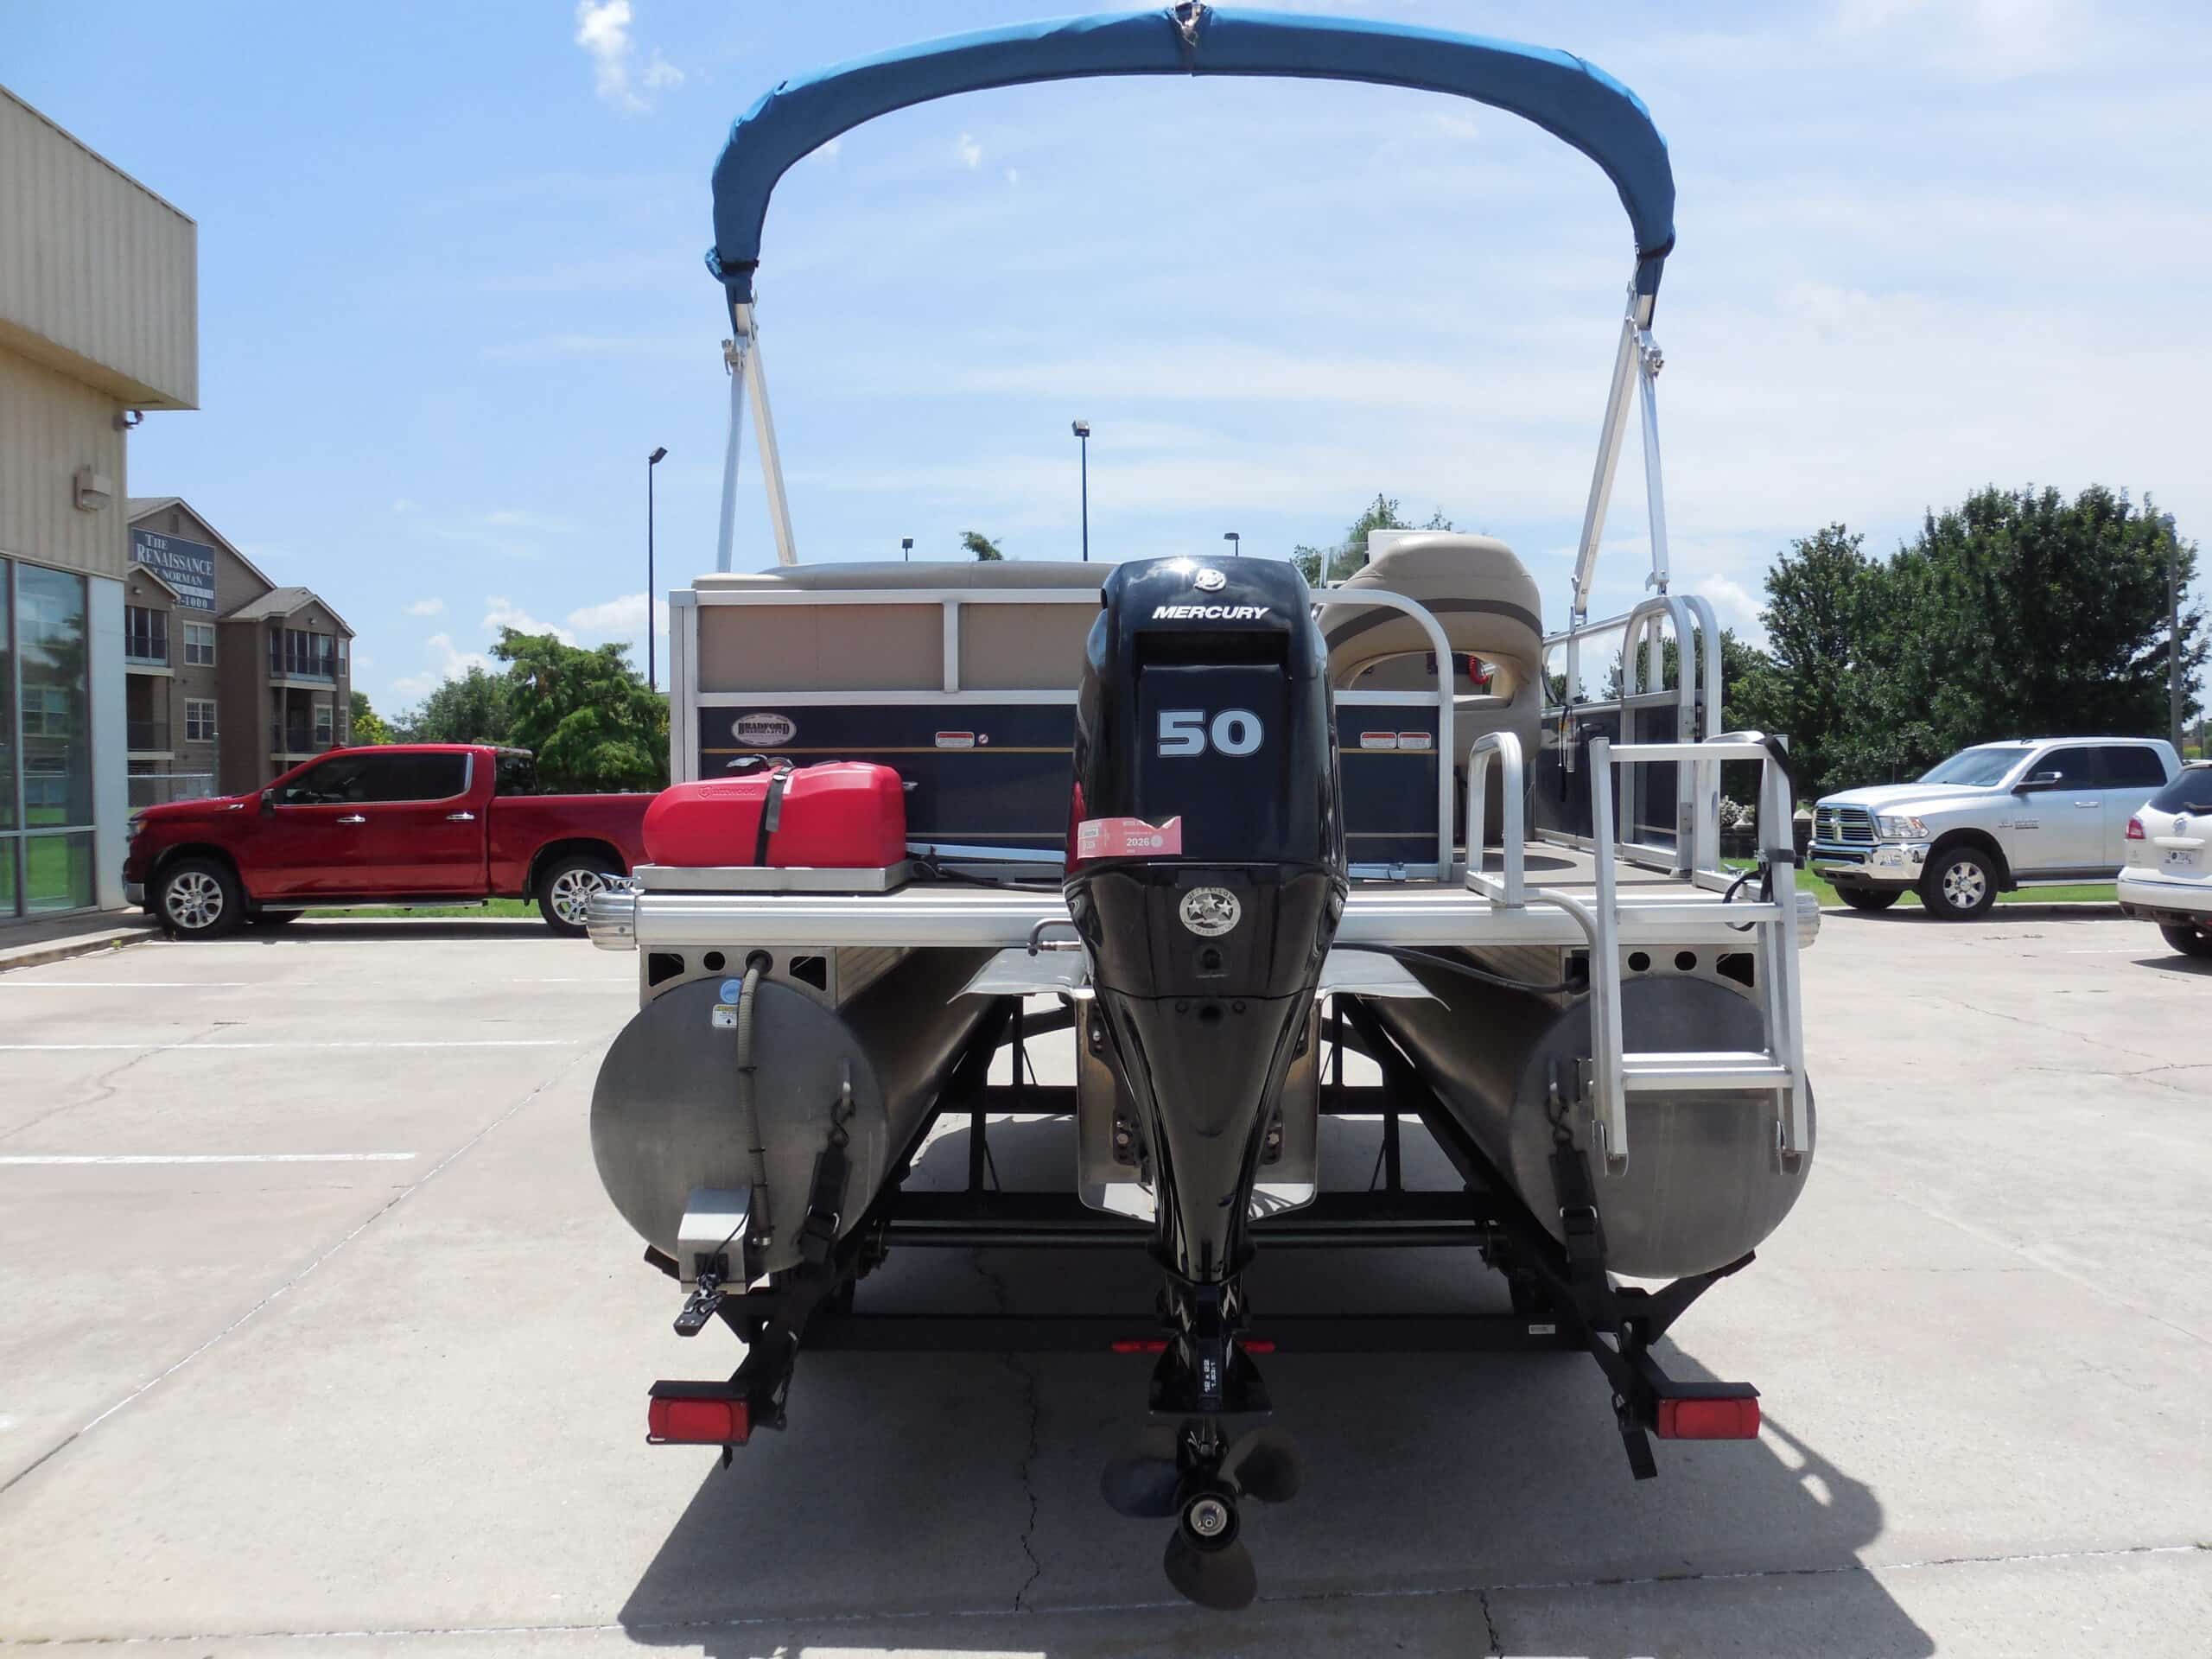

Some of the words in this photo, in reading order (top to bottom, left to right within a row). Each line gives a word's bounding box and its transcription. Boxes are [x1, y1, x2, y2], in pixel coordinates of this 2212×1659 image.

[144, 534, 168, 550] THE
[137, 543, 214, 576] RENAISSANCE
[162, 569, 202, 586] NORMAN
[1152, 606, 1271, 620] MERCURY
[738, 722, 790, 734] BRADFORD
[1158, 709, 1264, 757] 50
[1126, 837, 1150, 847] 2026
